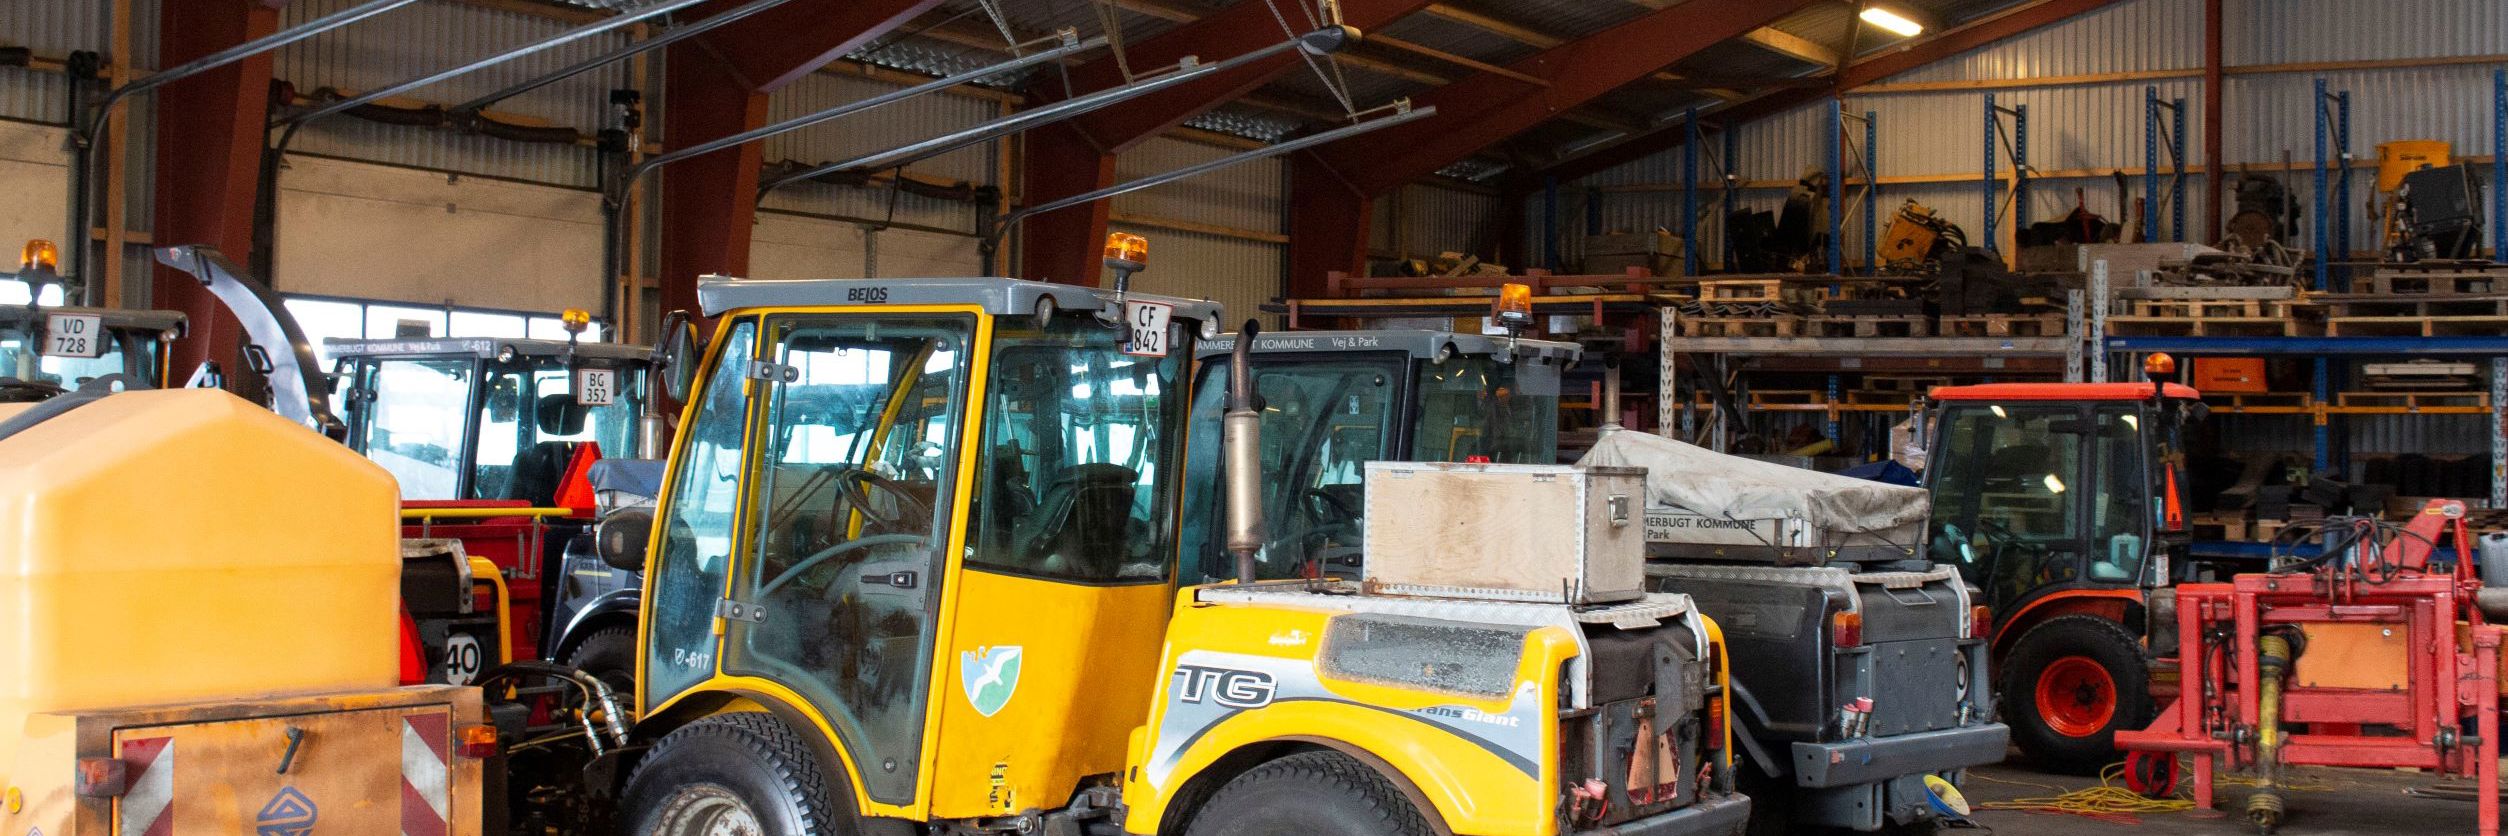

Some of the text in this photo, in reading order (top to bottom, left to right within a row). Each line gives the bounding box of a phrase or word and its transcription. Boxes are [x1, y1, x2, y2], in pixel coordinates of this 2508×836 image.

[1139, 305, 1156, 327] CF
[64, 319, 84, 333] VD
[57, 338, 86, 353] 728
[1134, 329, 1158, 352] 842
[1261, 339, 1313, 349] KOMMUNE
[1332, 337, 1345, 349] Vej
[1349, 337, 1356, 347] &
[1358, 336, 1378, 347] Park
[590, 373, 605, 387] BG
[586, 388, 607, 402] 352
[1696, 519, 1756, 530] KOMMUNE
[1648, 529, 1670, 540] Park
[447, 643, 479, 675] 40
[1173, 664, 1279, 709] TG
